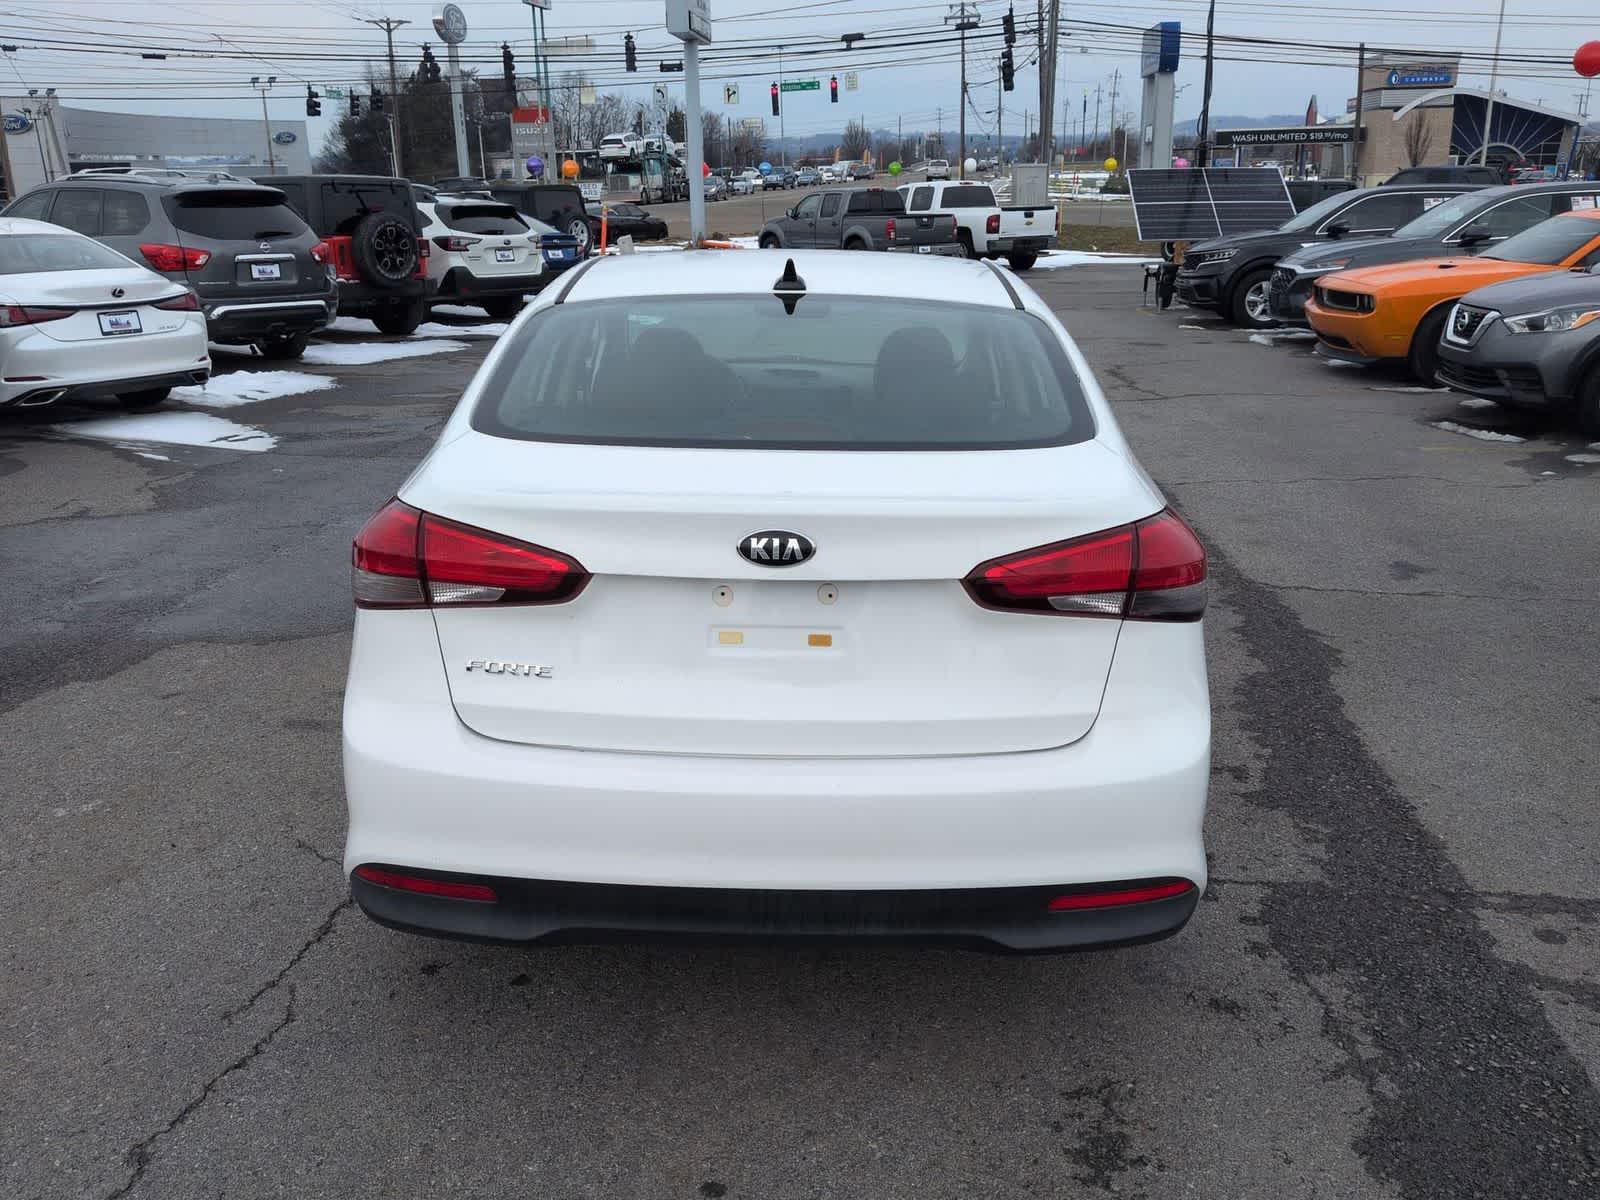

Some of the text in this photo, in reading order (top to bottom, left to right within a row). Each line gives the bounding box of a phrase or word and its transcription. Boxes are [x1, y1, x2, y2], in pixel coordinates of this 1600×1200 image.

[516, 127, 548, 135] ISUZU
[1232, 134, 1257, 142] WASH
[1260, 132, 1307, 141] UNLIMITED
[750, 537, 804, 560] KIA
[466, 659, 553, 679] FORTE
